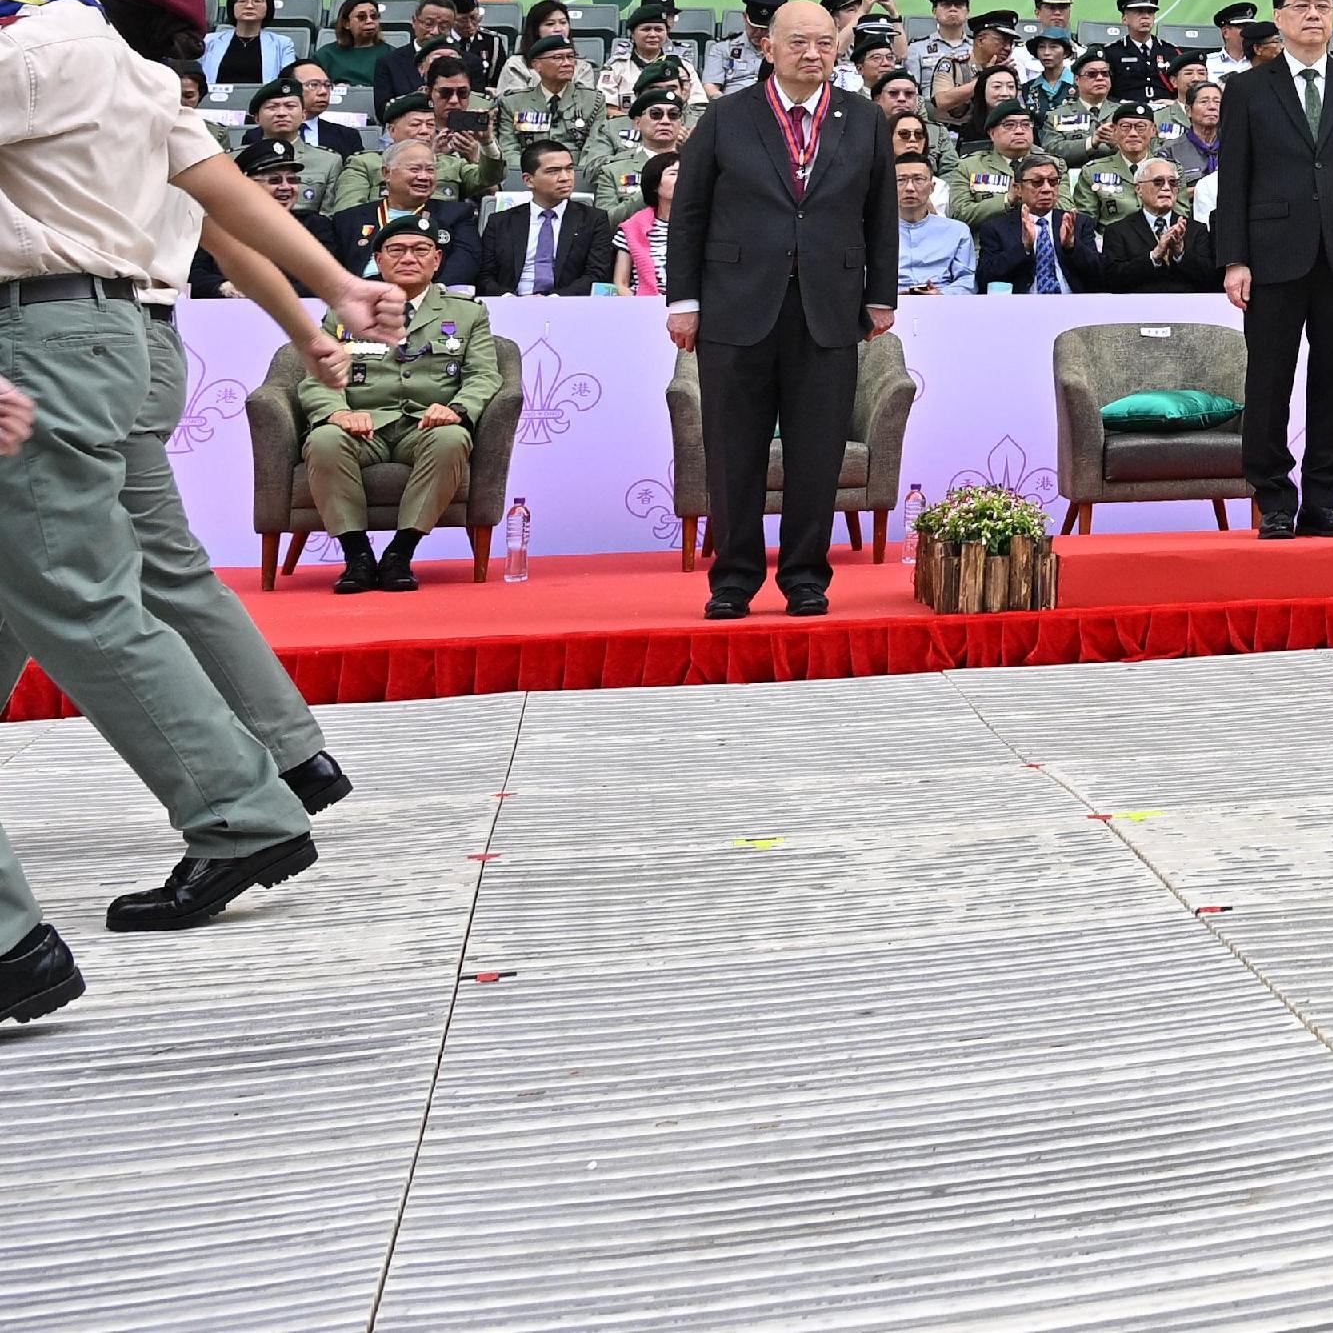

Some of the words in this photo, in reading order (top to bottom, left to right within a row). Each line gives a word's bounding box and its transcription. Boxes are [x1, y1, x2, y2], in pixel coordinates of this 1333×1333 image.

[214, 387, 239, 405] 港
[569, 382, 591, 397] 港
[1034, 476, 1054, 492] 港
[635, 487, 656, 506] 香
